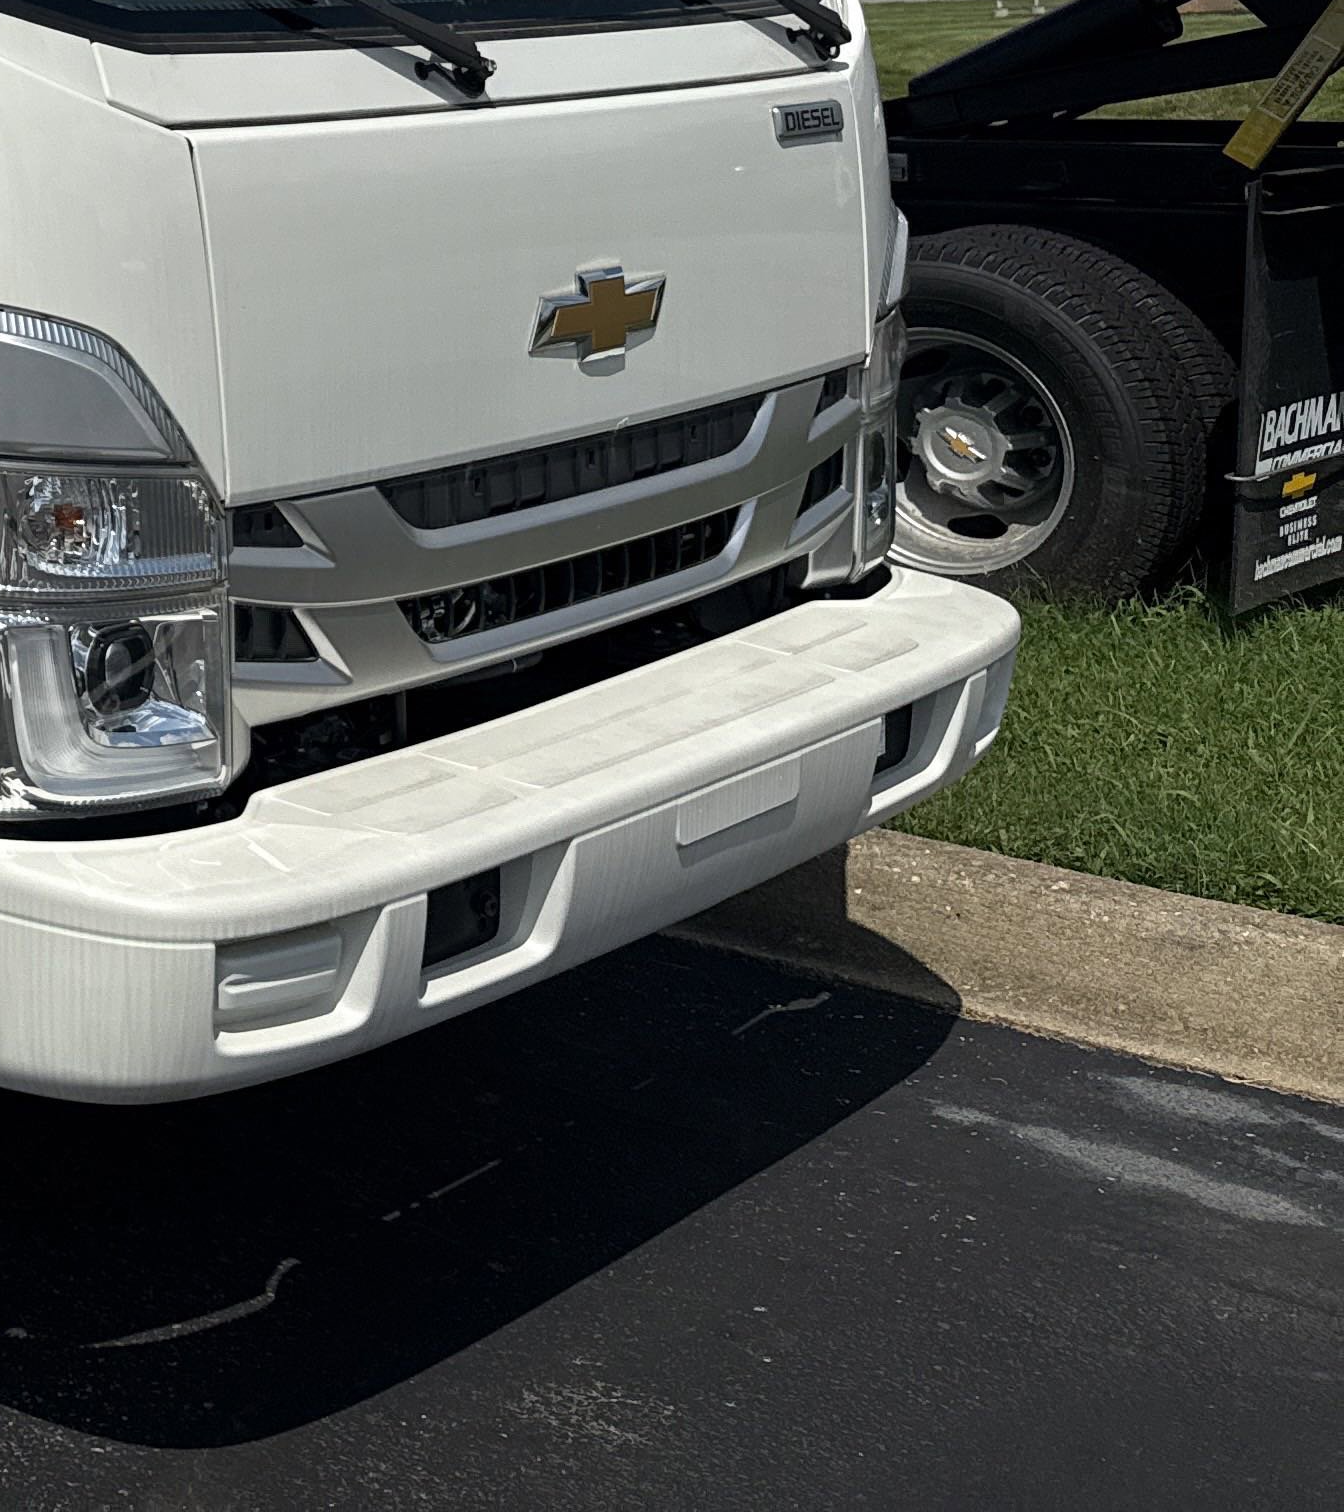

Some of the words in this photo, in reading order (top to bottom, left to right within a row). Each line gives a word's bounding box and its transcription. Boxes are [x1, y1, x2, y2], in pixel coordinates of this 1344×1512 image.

[784, 107, 840, 132] DIESEL
[1271, 439, 1344, 472] COMMERCIA
[1279, 514, 1318, 538] BUSINESS
